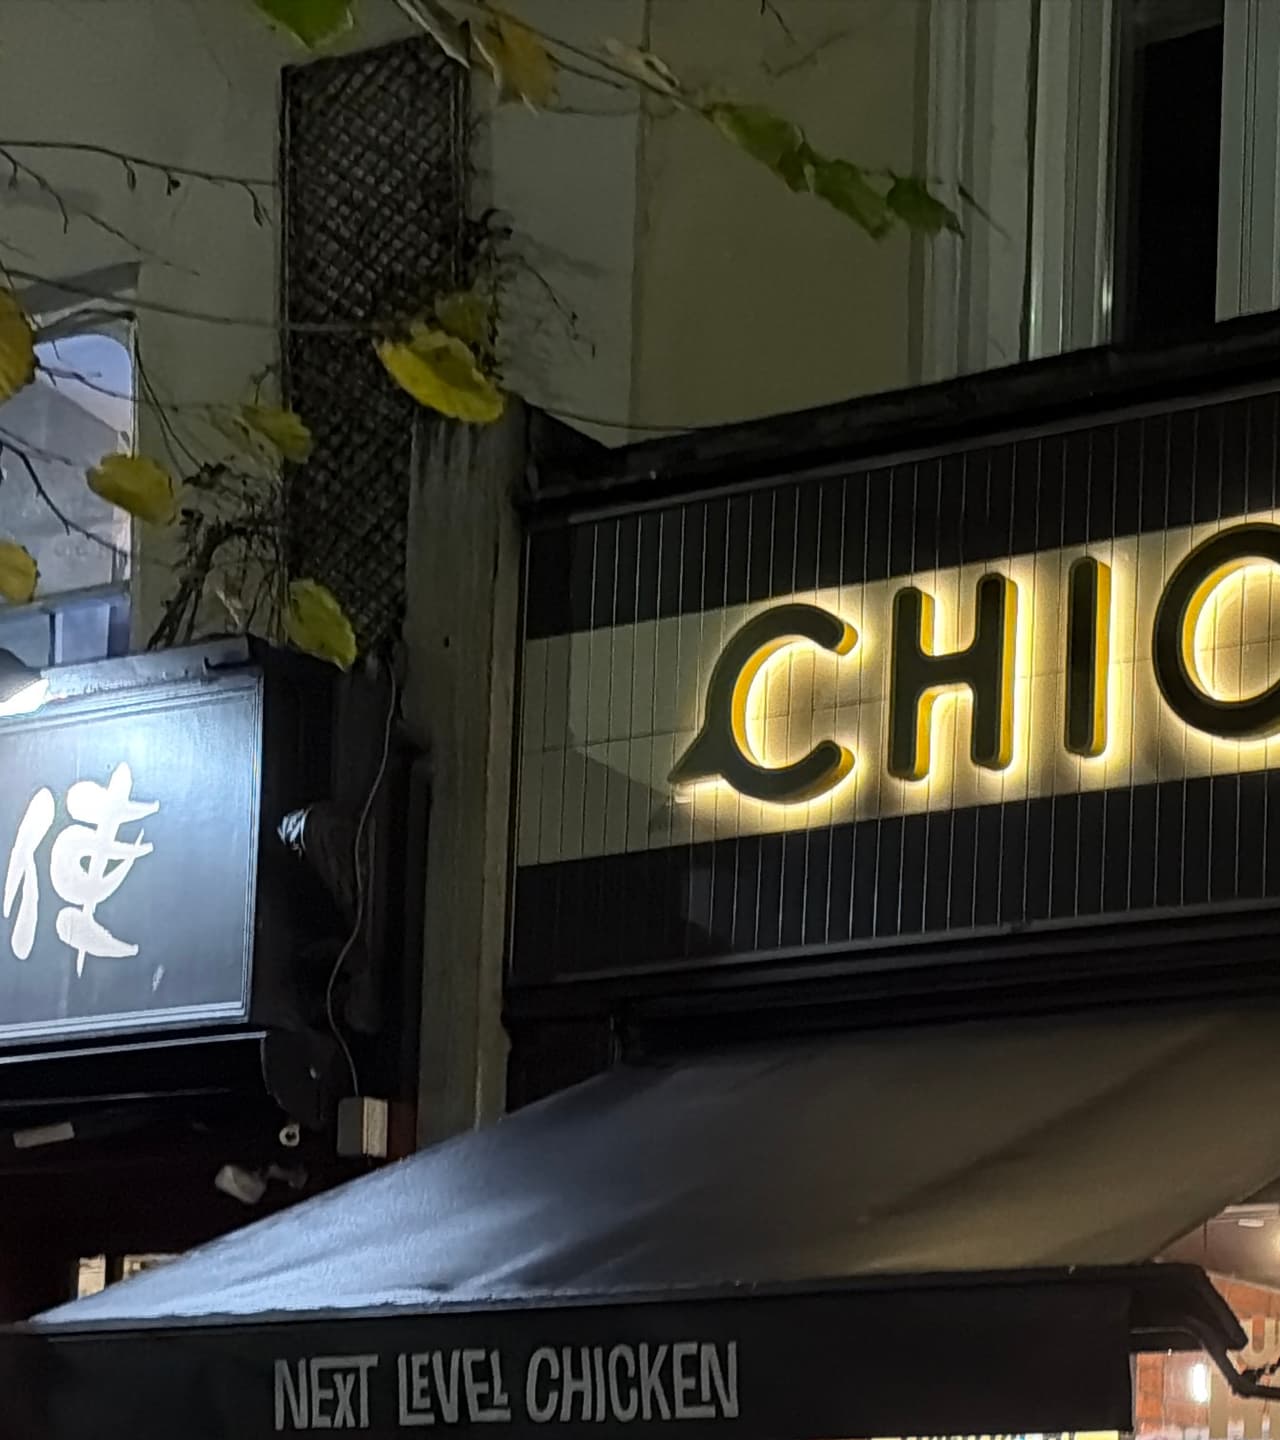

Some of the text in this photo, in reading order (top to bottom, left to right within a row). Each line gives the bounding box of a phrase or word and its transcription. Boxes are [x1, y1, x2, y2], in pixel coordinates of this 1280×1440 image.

[274, 1340, 740, 1431] NEXT LEVEL CHICKEN
